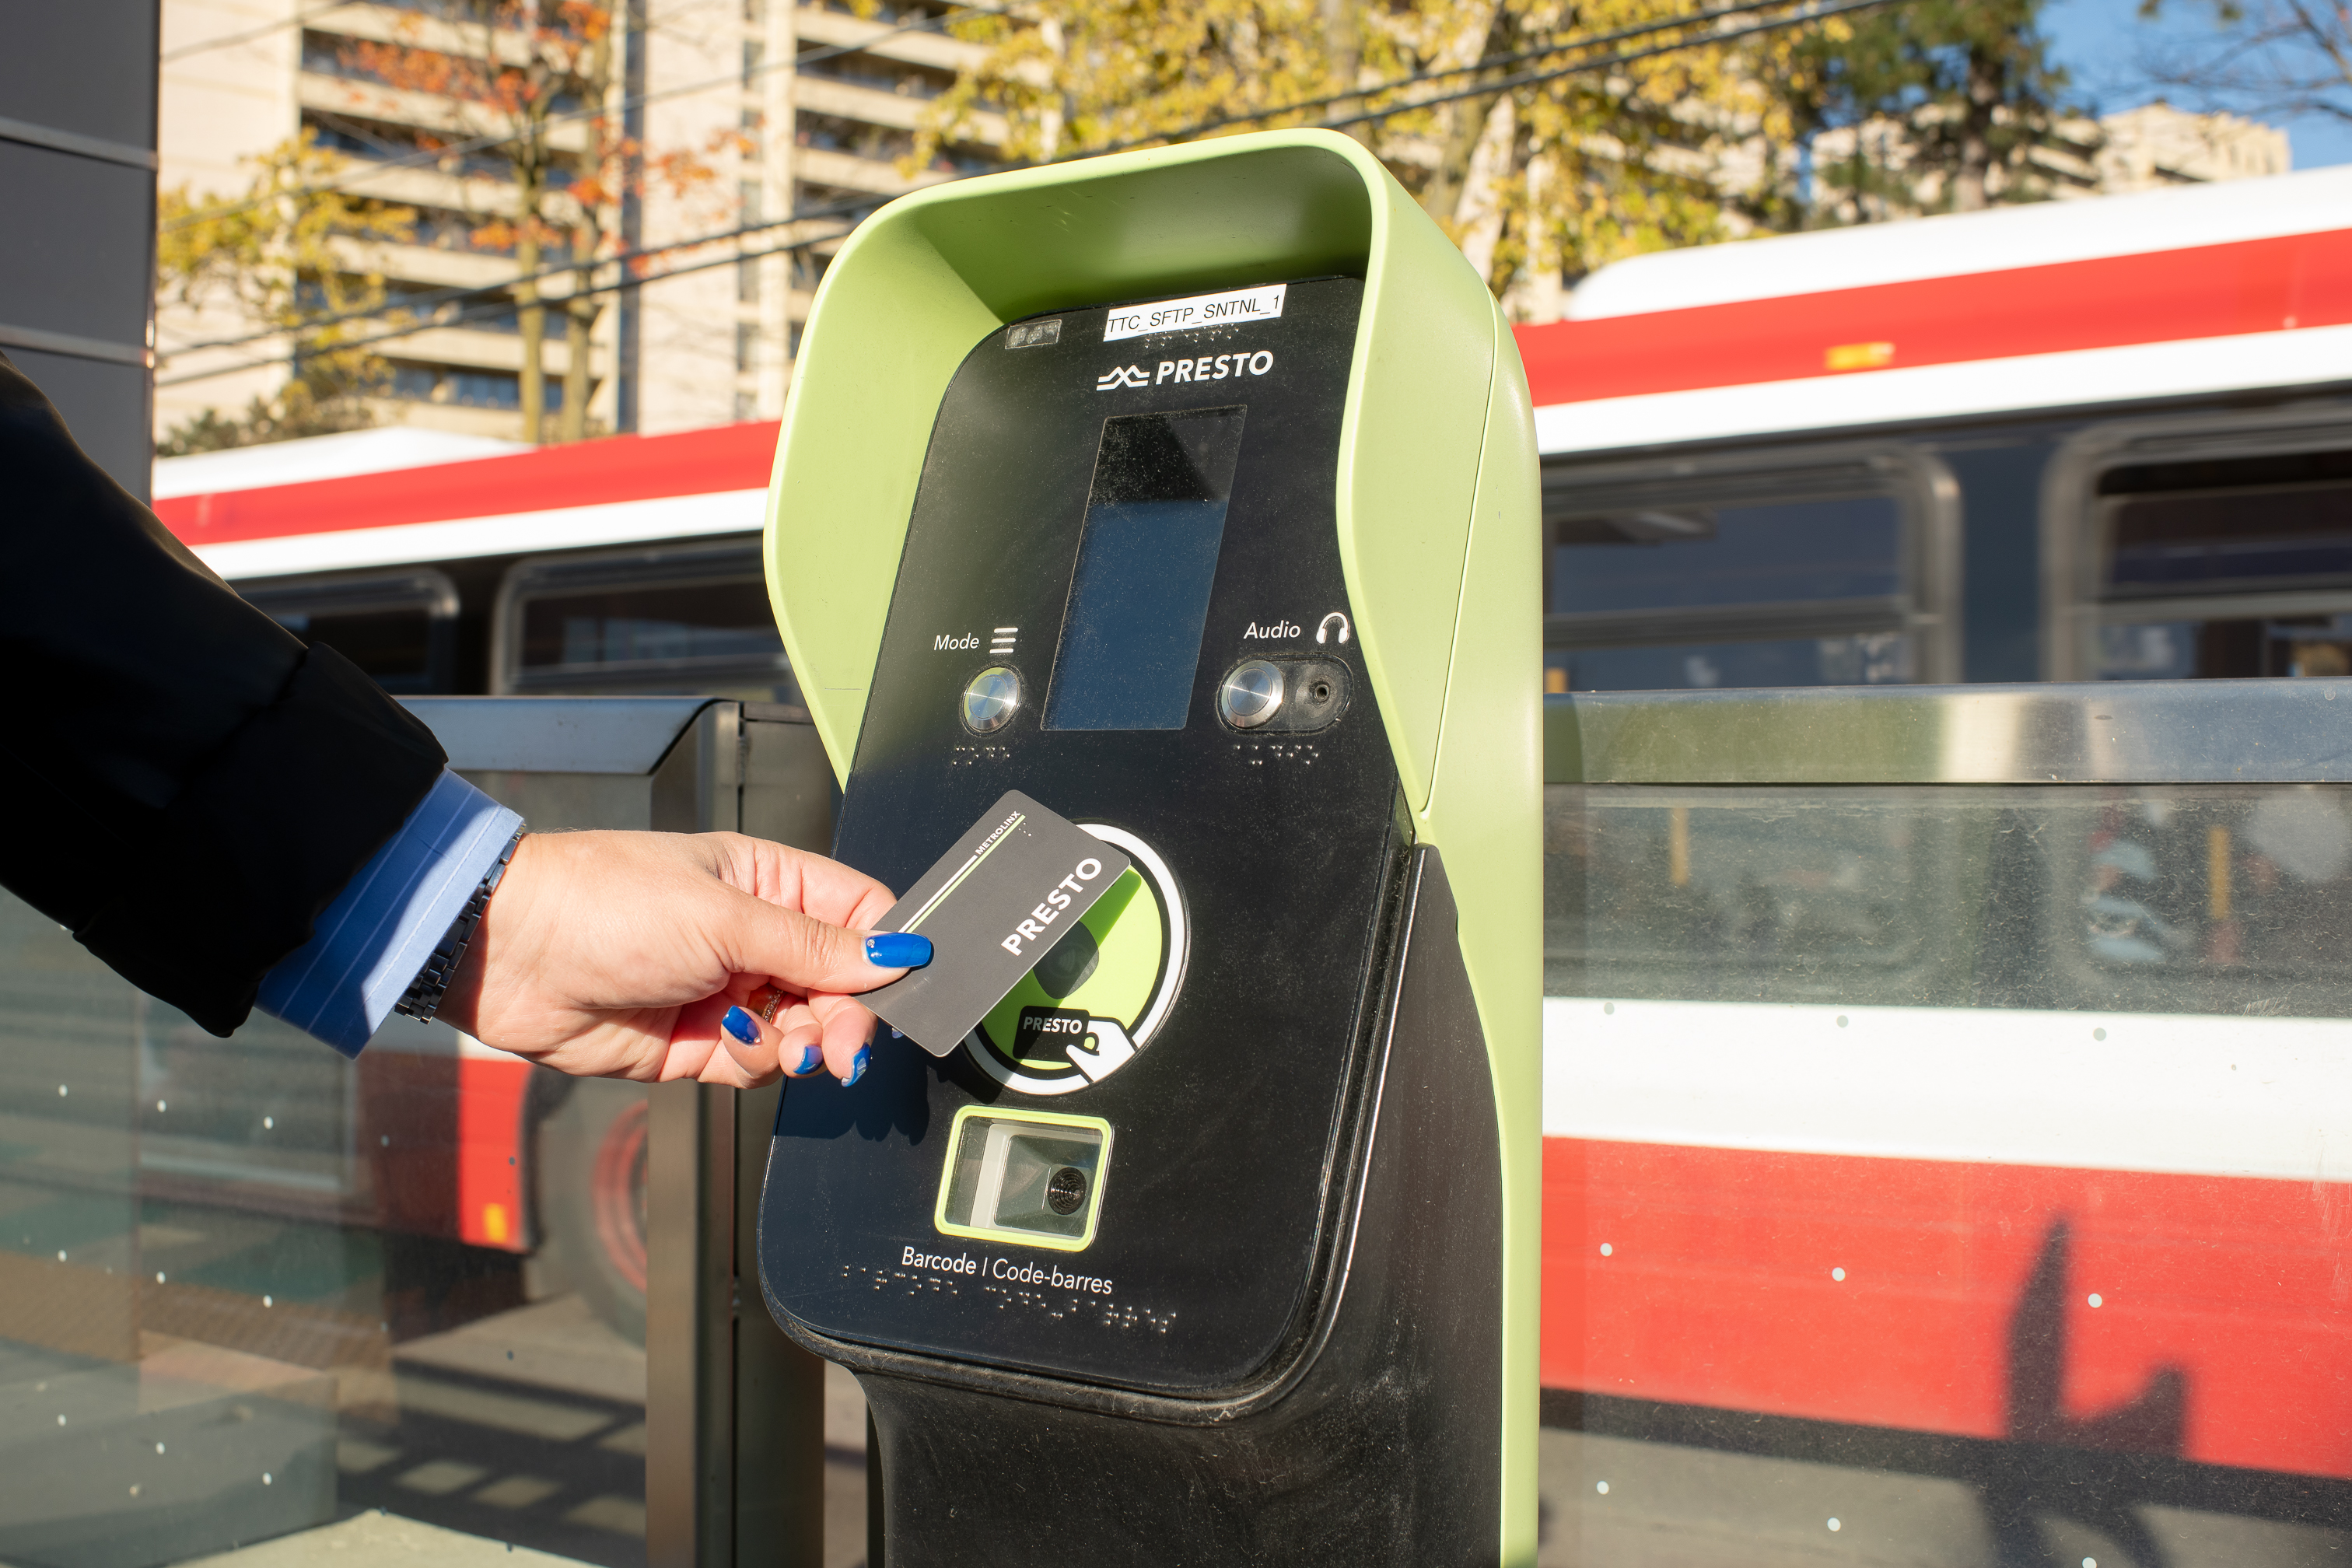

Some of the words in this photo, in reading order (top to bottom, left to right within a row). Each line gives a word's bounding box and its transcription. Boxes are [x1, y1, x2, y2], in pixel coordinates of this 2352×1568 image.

[1108, 295, 1279, 332] TTC_SFTP_SNTNL_1
[1156, 350, 1274, 384] PRESTO
[933, 632, 980, 651] Mode
[1243, 619, 1301, 640] Audio
[975, 810, 1021, 856] METROLINX
[1000, 857, 1103, 957] PRESTO
[1023, 1016, 1083, 1034] PRESTO
[901, 1245, 977, 1275] Barcode
[992, 1258, 1113, 1295] Code-barres
